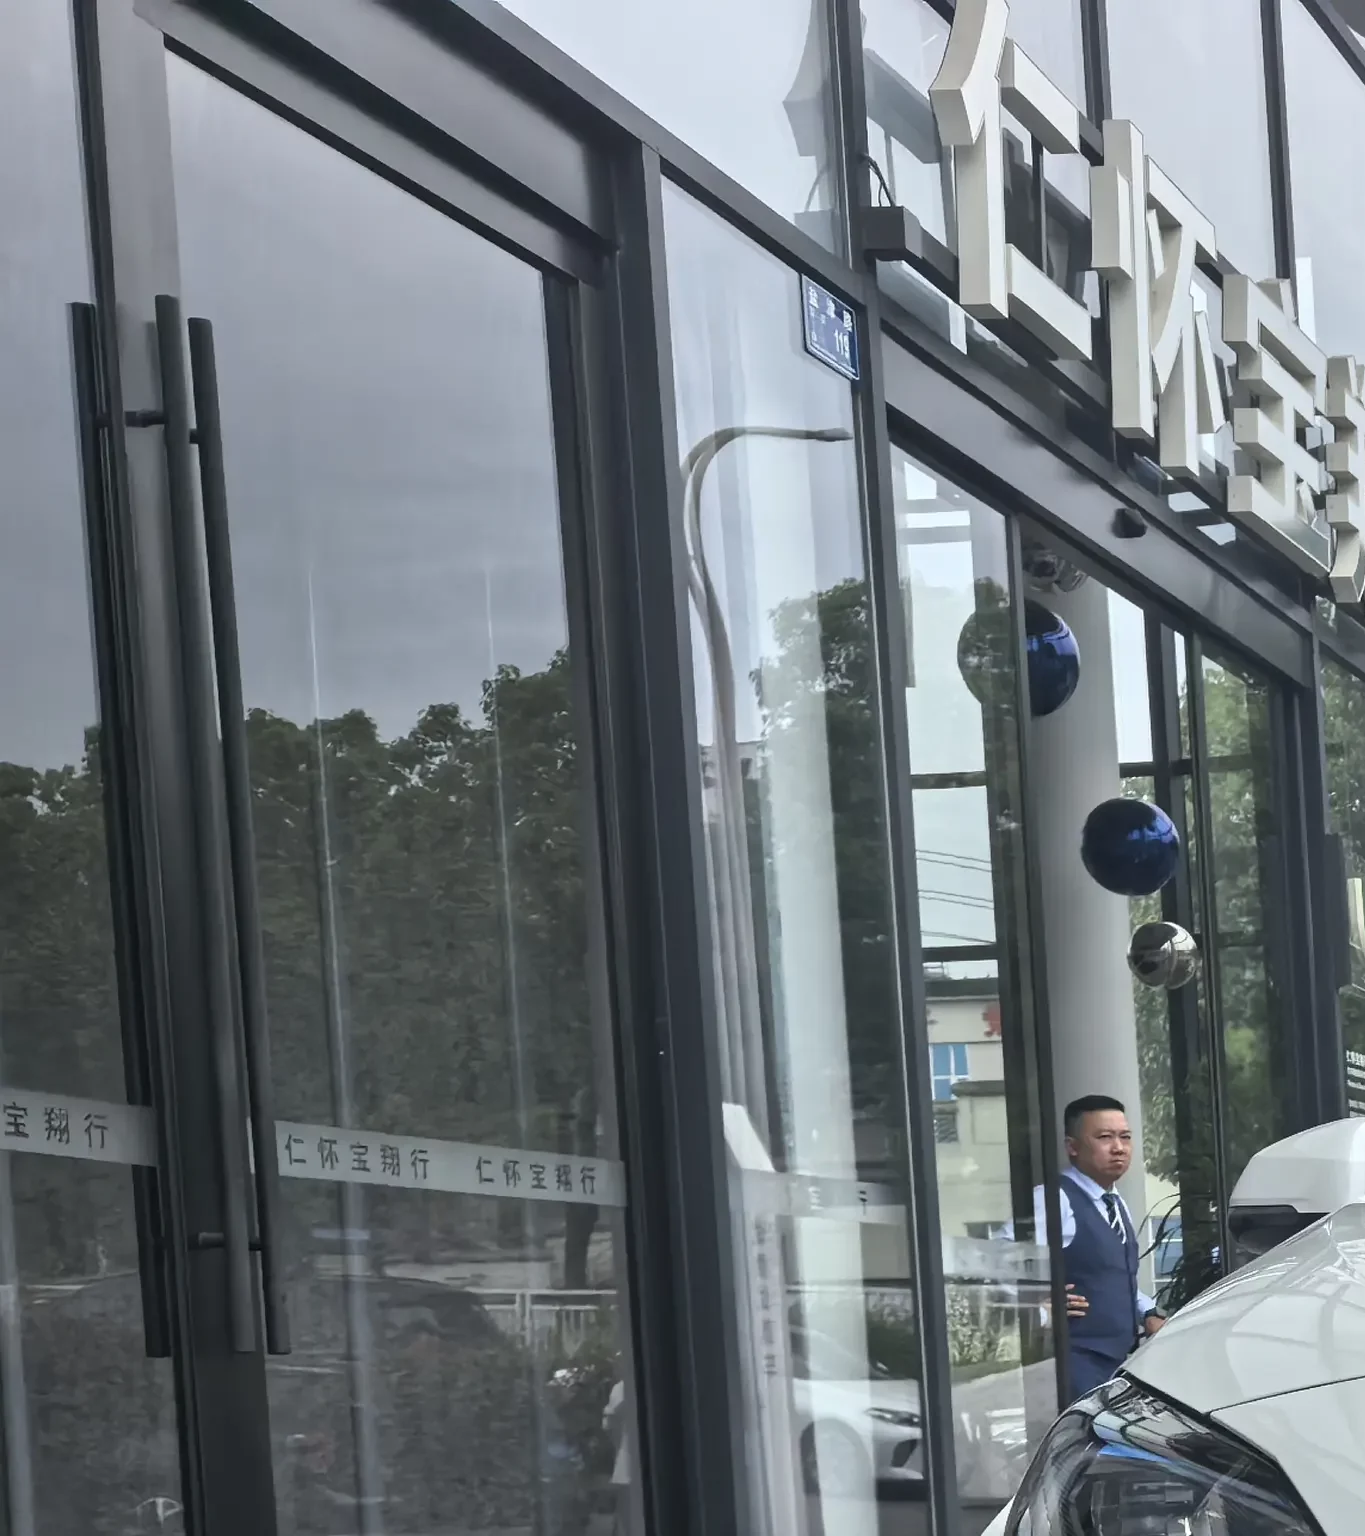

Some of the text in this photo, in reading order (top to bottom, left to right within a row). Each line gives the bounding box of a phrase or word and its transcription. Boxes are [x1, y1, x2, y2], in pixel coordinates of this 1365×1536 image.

[3, 1101, 108, 1149] 宝翔行
[285, 1133, 597, 1195] 仁怀宝翔行 仁怀宝翔行
